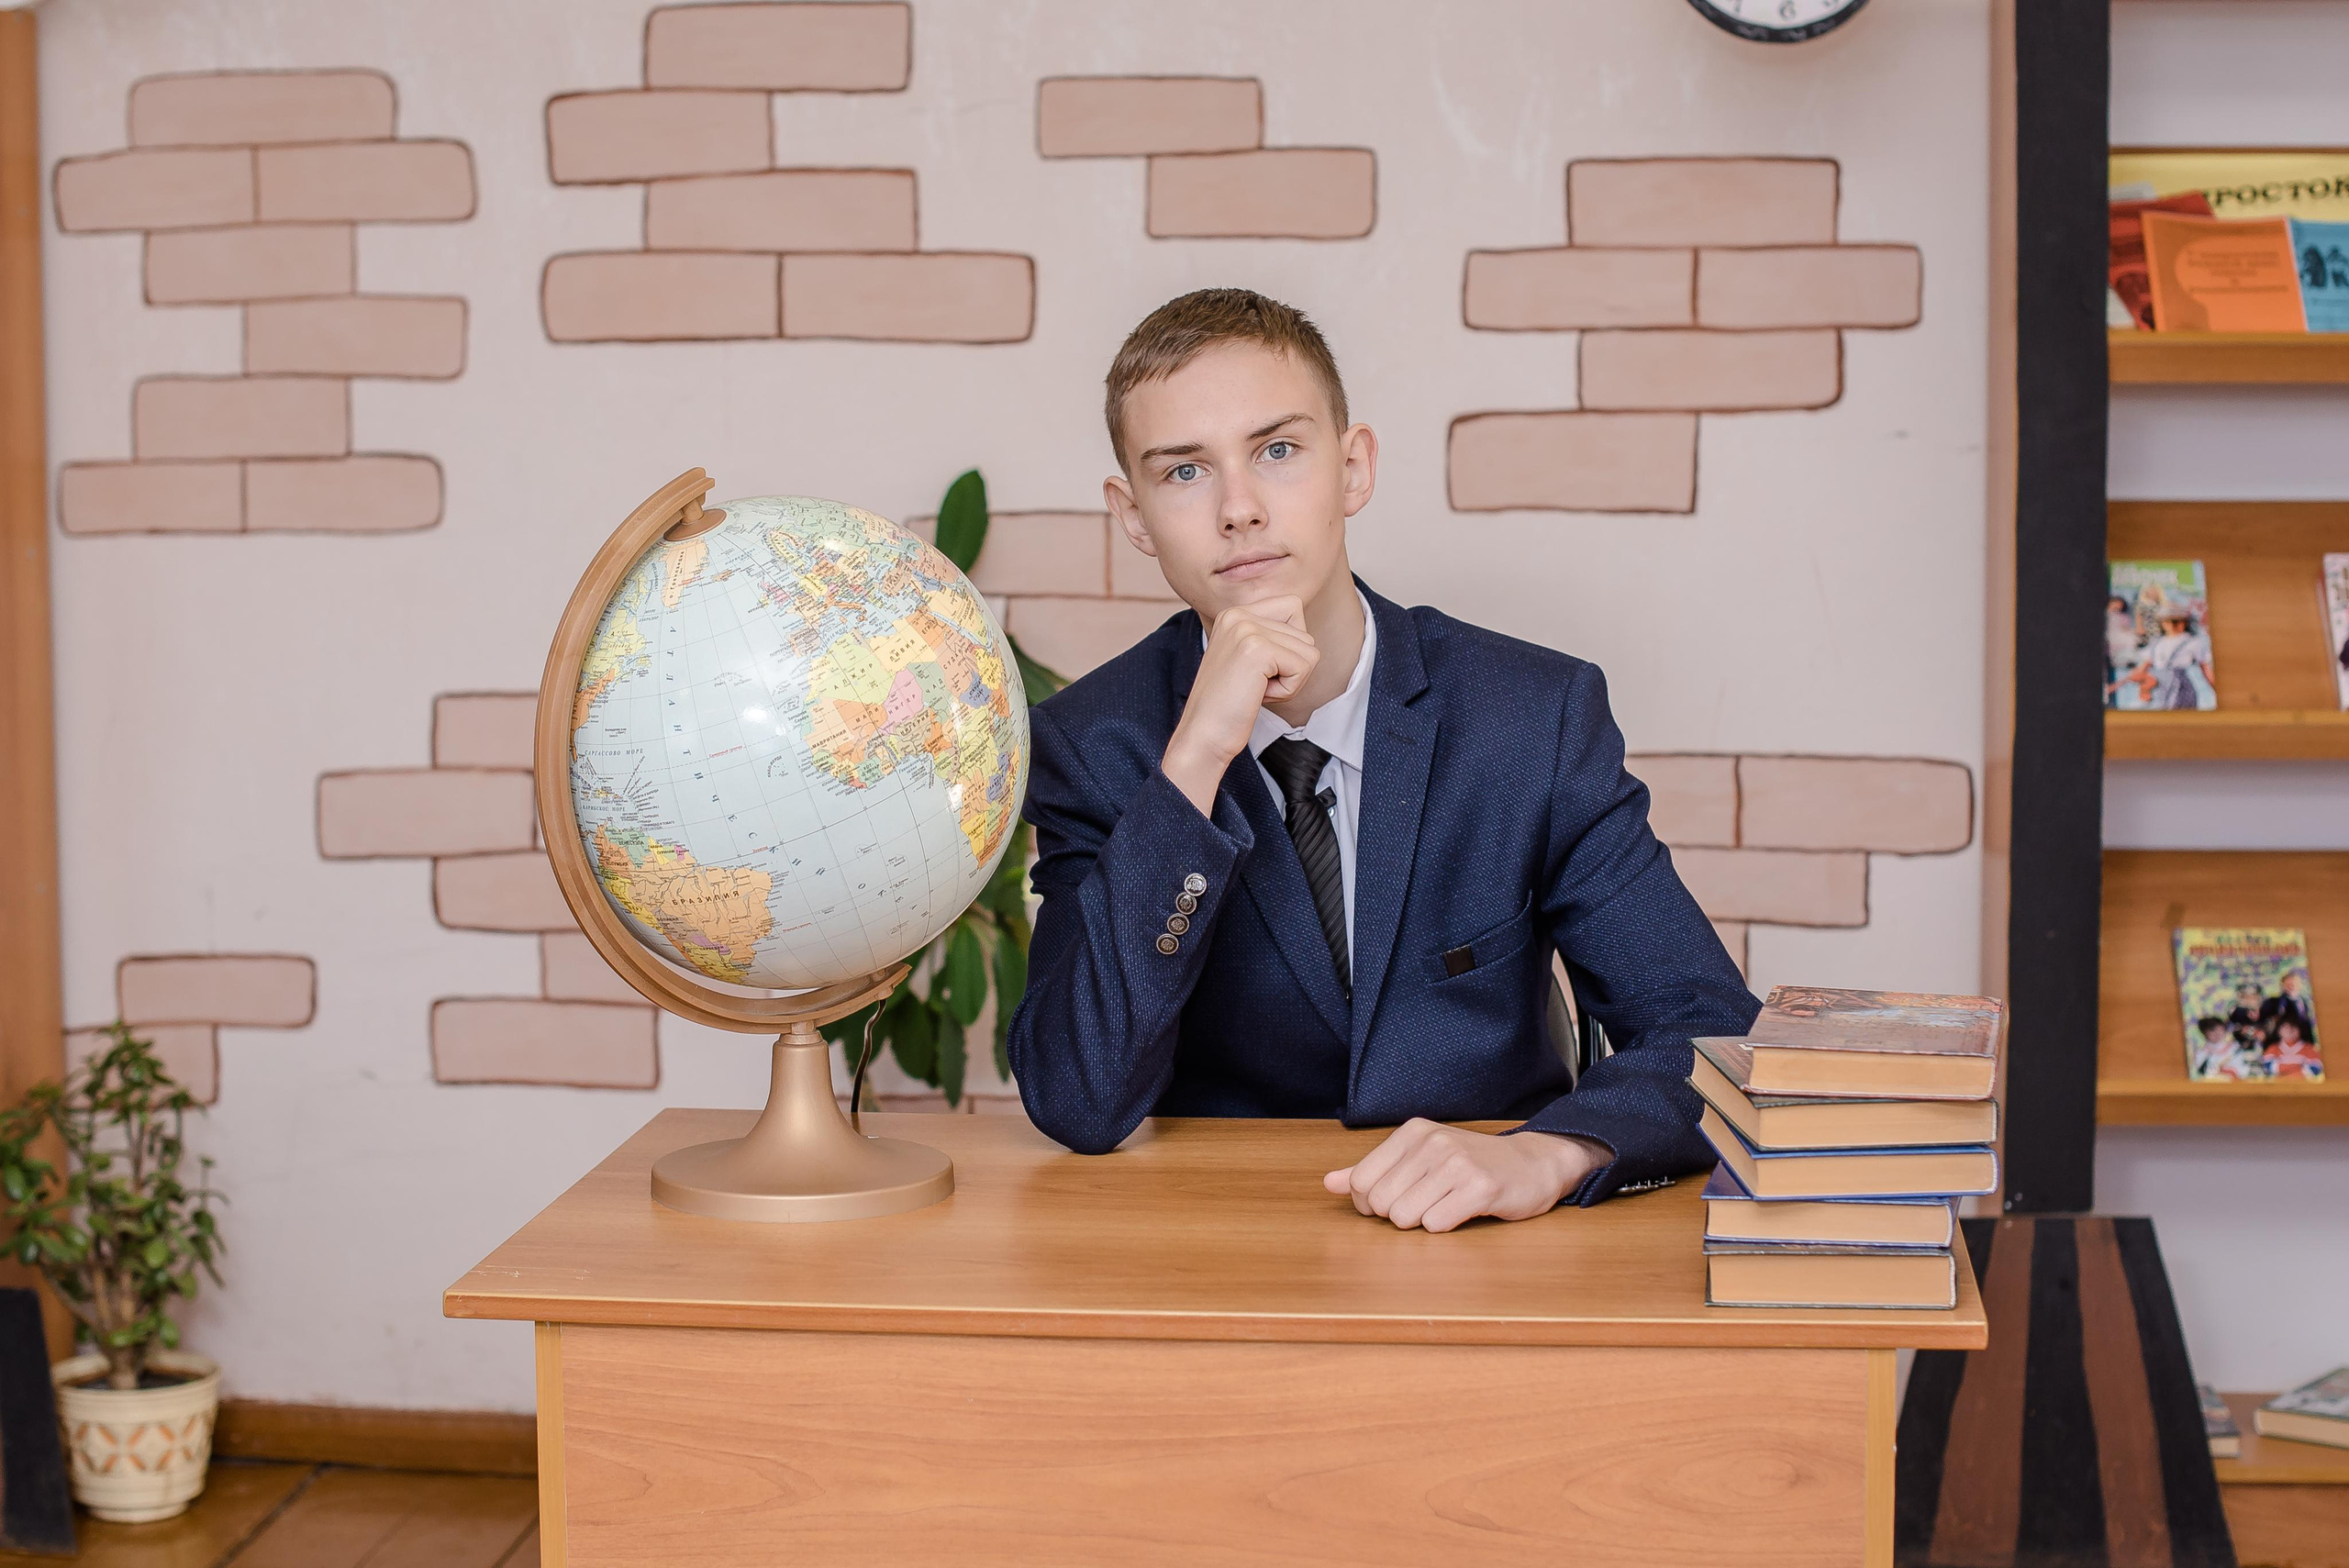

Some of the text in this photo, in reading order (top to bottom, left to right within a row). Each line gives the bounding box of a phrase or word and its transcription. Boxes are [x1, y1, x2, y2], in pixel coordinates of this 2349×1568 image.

[670, 550, 685, 590] Гренландия
[794, 628, 816, 640] ИСПАНИЯ
[890, 639, 915, 662] ЛИВИЯ
[943, 648, 962, 670] СУДАН
[834, 663, 873, 691] АЛЖИР
[926, 678, 943, 695] ЧАД
[888, 694, 916, 715] НИГЕР
[856, 707, 878, 723] МАЛИ
[900, 712, 929, 735] НИГЕРИЯ
[812, 729, 846, 749] МАВРИТАНИЯ
[813, 754, 832, 765] СЕНЕГАЛ
[881, 763, 893, 772] ГАНА
[672, 891, 740, 906] БРАЗИЛИЯ
